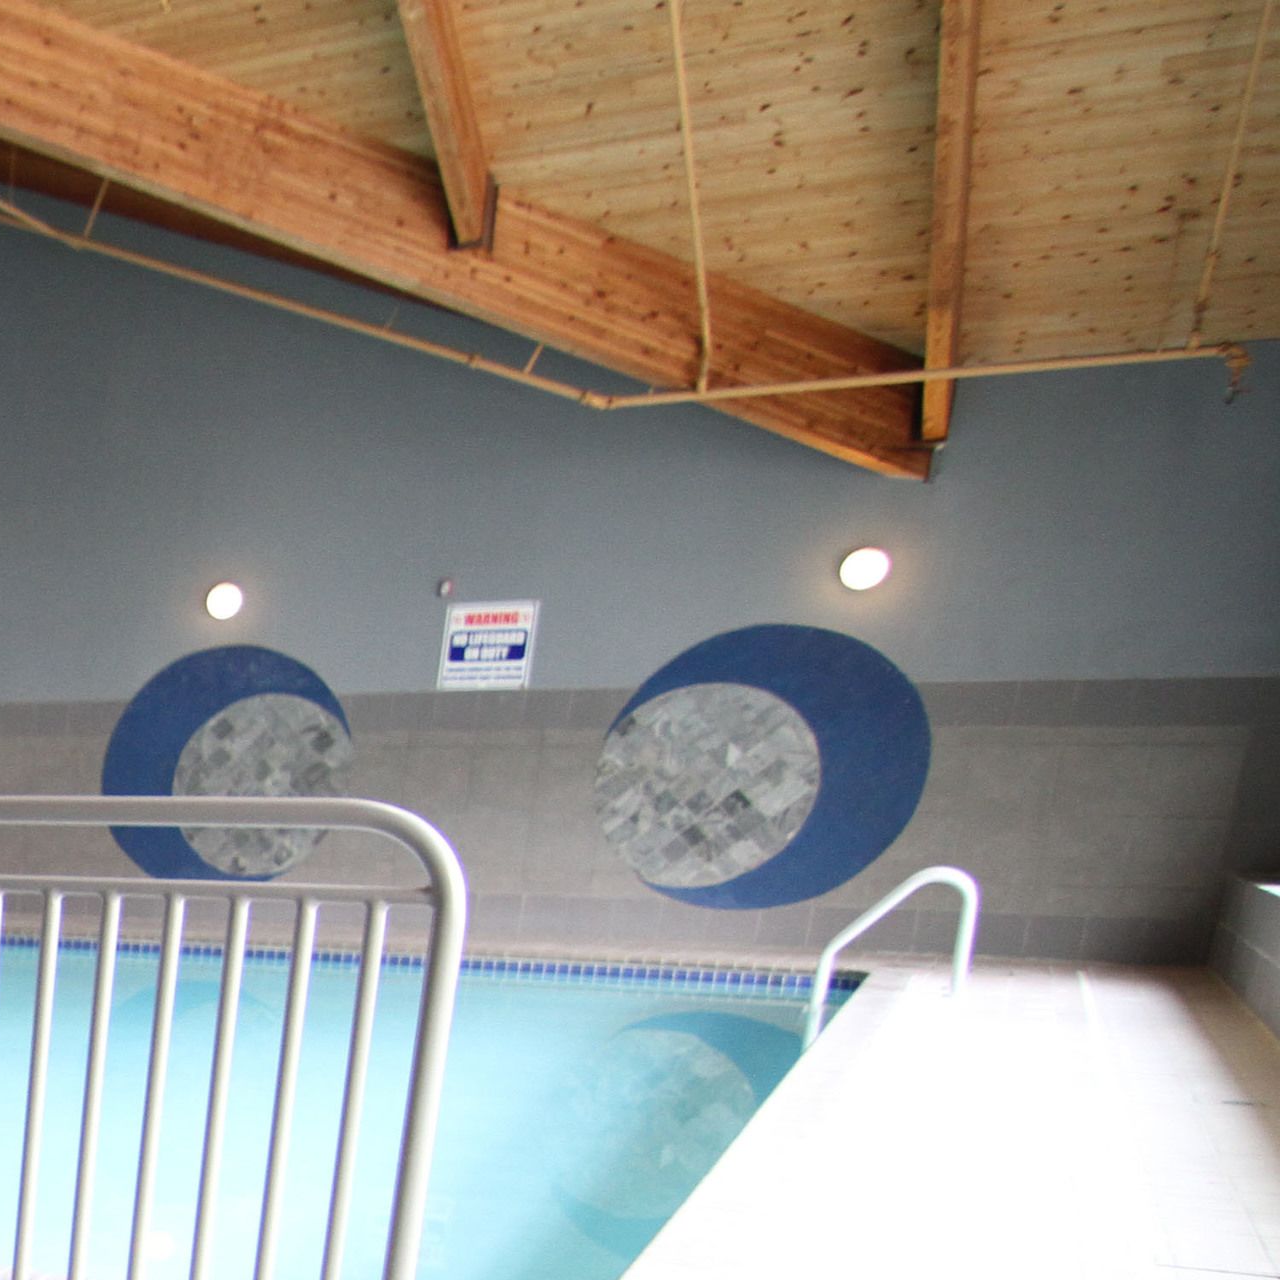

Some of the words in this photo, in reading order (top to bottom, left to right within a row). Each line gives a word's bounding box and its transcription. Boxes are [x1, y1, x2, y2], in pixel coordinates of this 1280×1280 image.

[465, 612, 519, 625] WARNING
[452, 633, 467, 646] NO
[469, 631, 525, 646] LIFEGUARD
[464, 647, 479, 659] ON
[481, 646, 509, 659] DUTY
